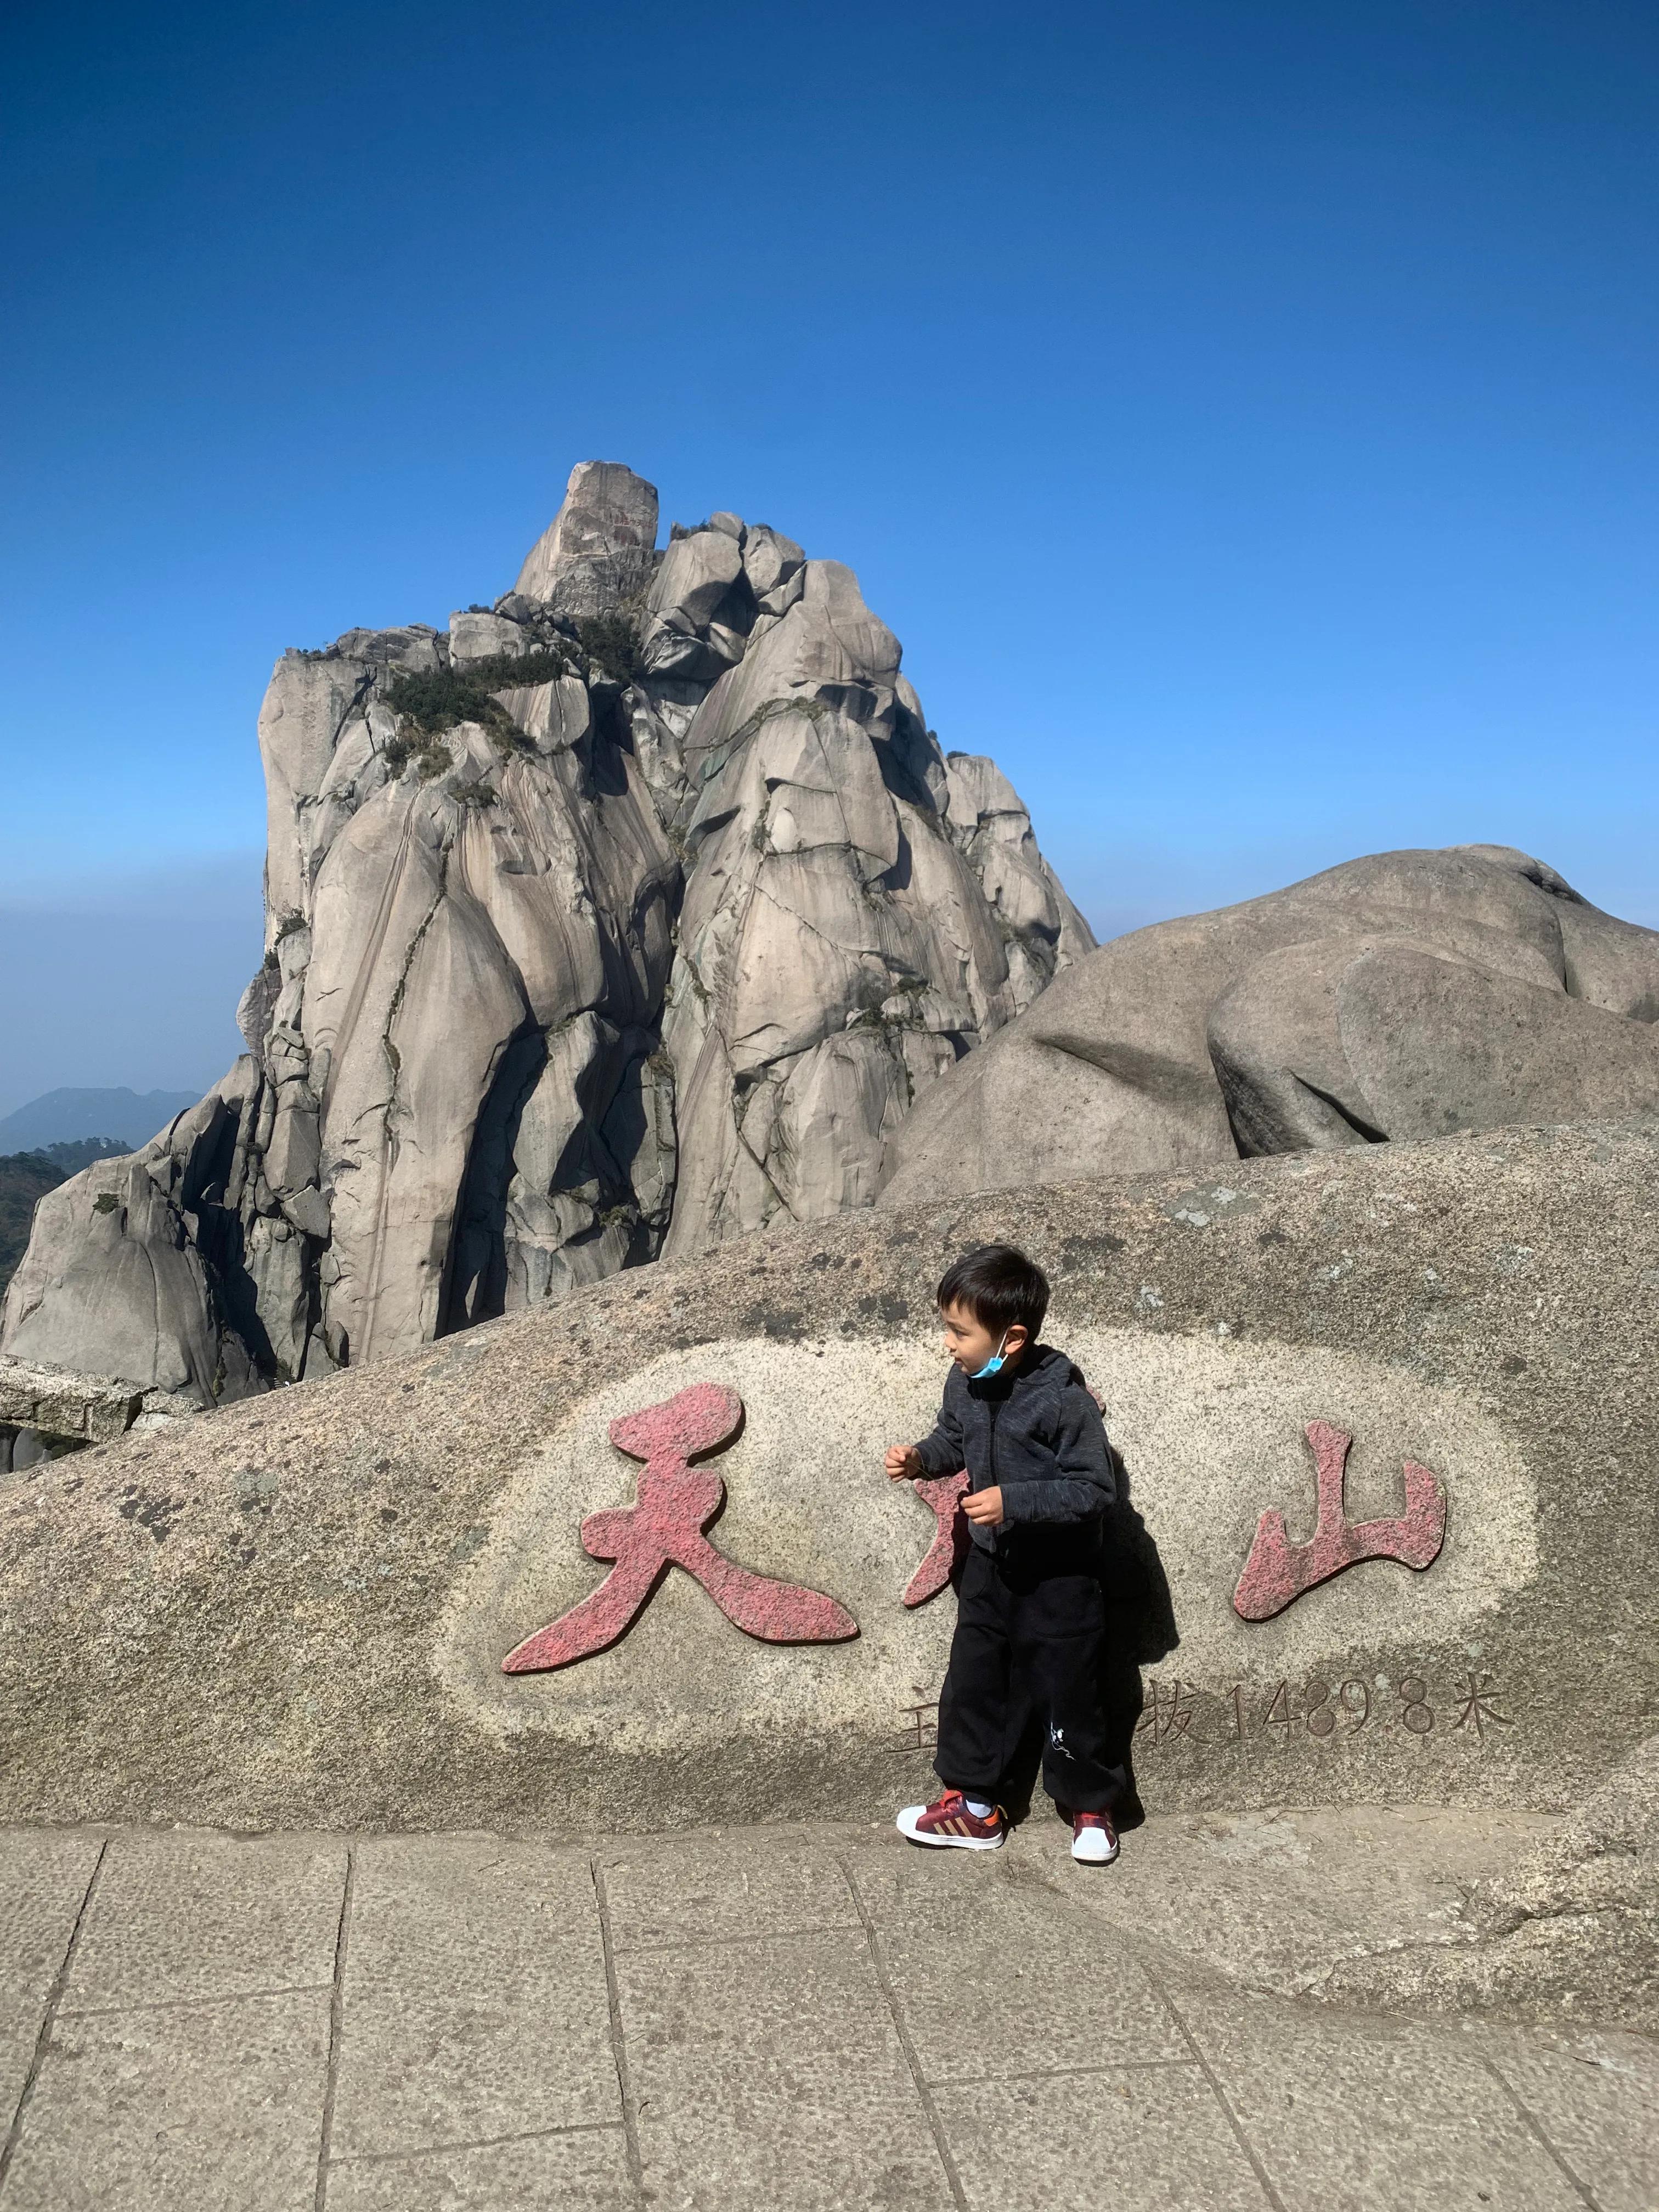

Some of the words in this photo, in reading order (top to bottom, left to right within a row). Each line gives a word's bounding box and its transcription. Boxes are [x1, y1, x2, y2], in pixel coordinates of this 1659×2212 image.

[501, 1382, 1447, 1676] 天山
[884, 1673, 1516, 1753] 主拔1489.8米
